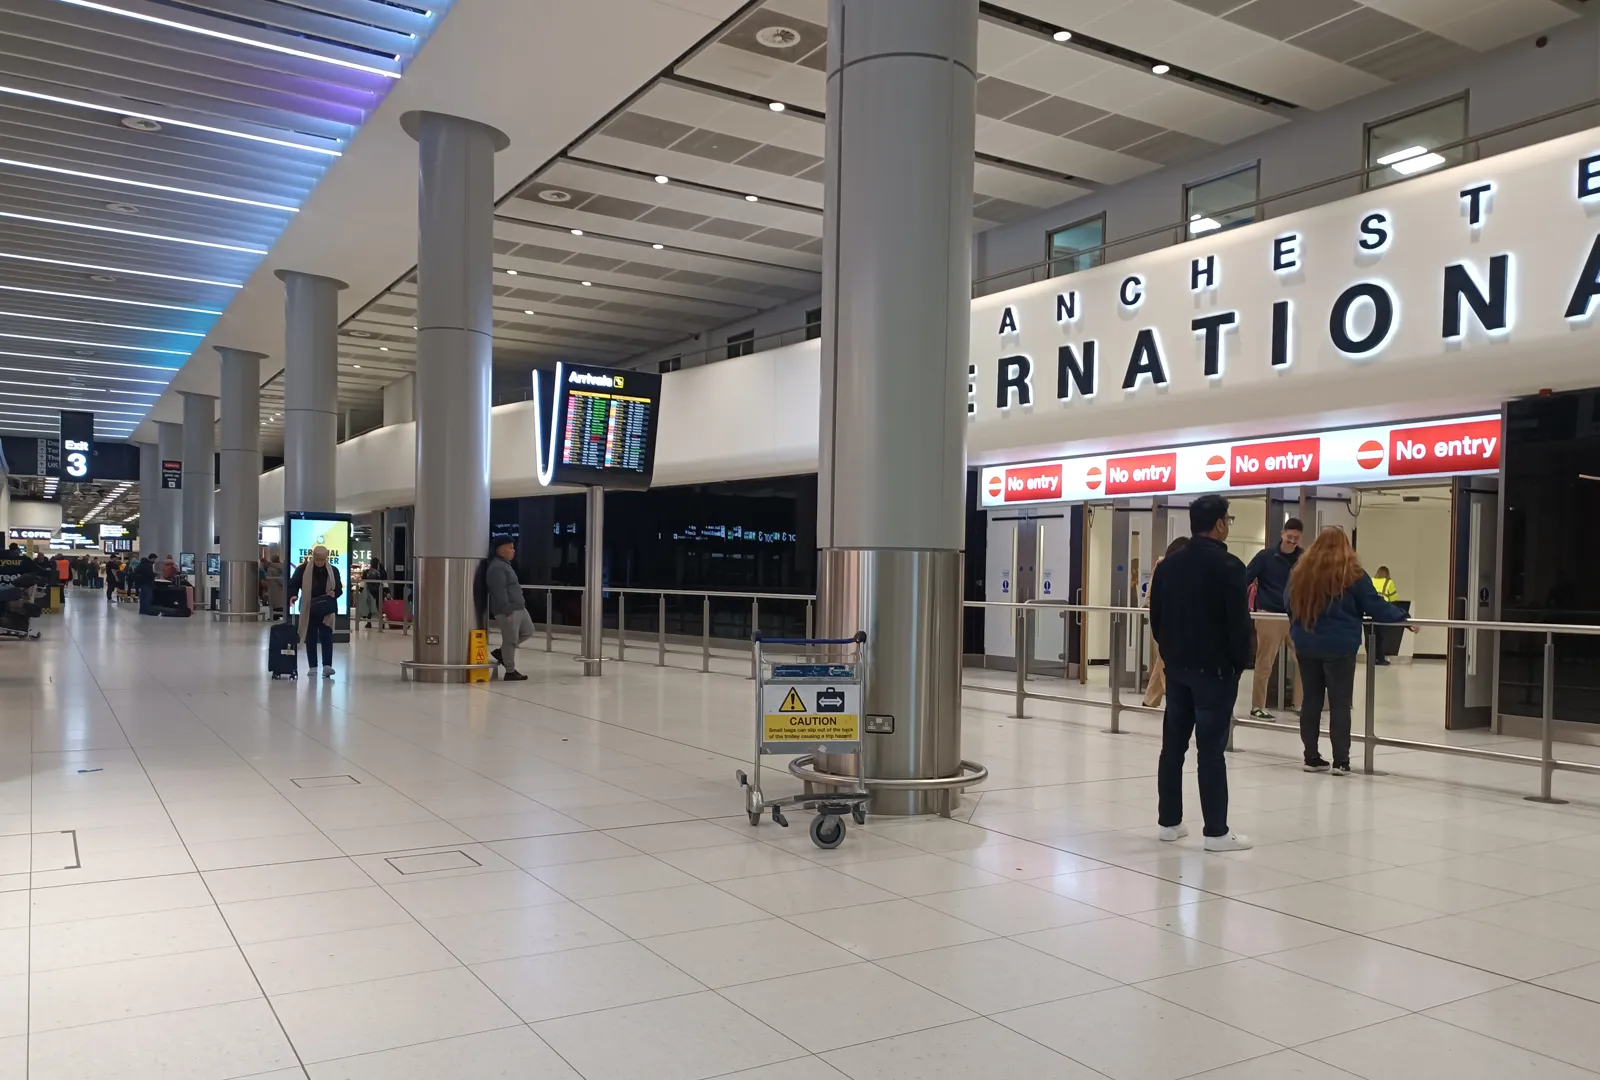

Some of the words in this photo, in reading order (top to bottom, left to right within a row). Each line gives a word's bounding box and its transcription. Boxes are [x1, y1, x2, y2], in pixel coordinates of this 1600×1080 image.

[568, 371, 612, 387] Arrivals
[65, 439, 89, 451] Exit
[1396, 439, 1427, 461] No
[1433, 435, 1497, 458] entry
[66, 452, 88, 477] 3
[1234, 454, 1260, 472] No
[1264, 451, 1313, 472] entry
[1007, 476, 1024, 491] No
[1026, 474, 1059, 490] entry
[1109, 466, 1128, 483] No
[1132, 464, 1172, 482] entry
[789, 717, 837, 726] CAUTION
